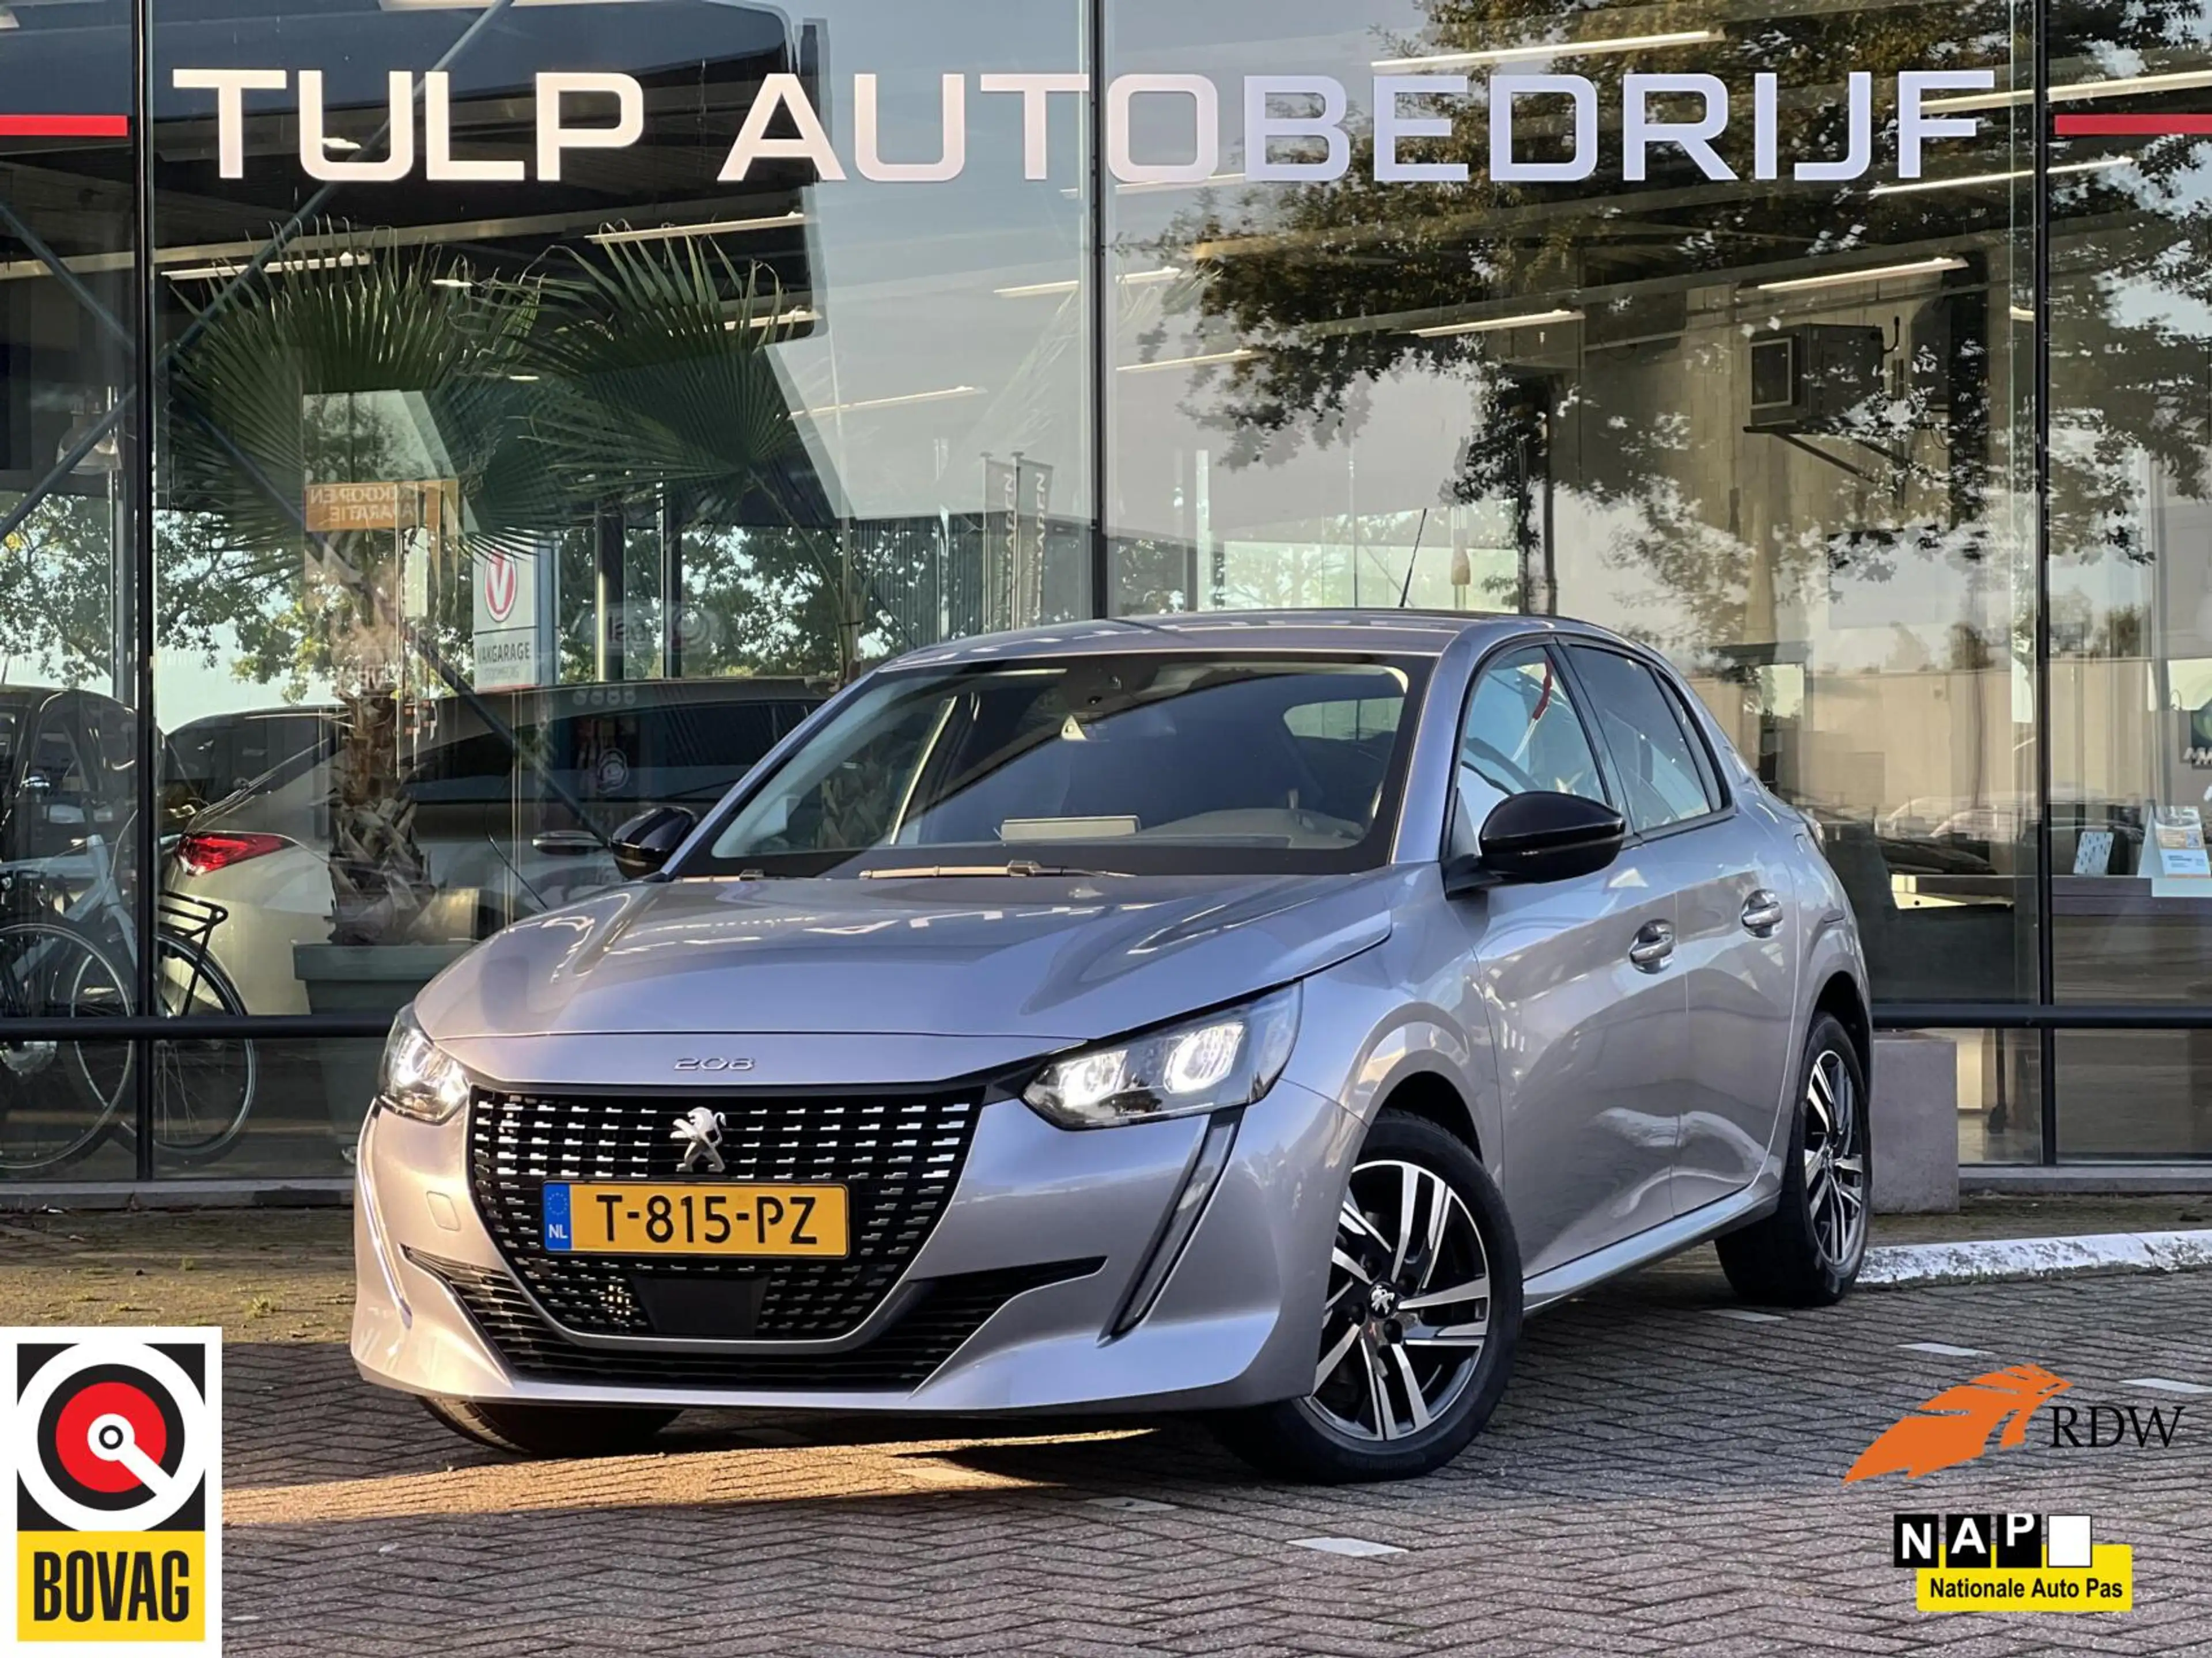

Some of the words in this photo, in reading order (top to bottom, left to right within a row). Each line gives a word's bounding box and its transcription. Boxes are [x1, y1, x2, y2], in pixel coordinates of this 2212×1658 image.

[173, 69, 643, 181] TULP
[717, 70, 1996, 183] AUTOBEDRIJF
[674, 1057, 755, 1071] 208
[549, 1224, 568, 1239] NL
[596, 1195, 817, 1245] T-815-PZ
